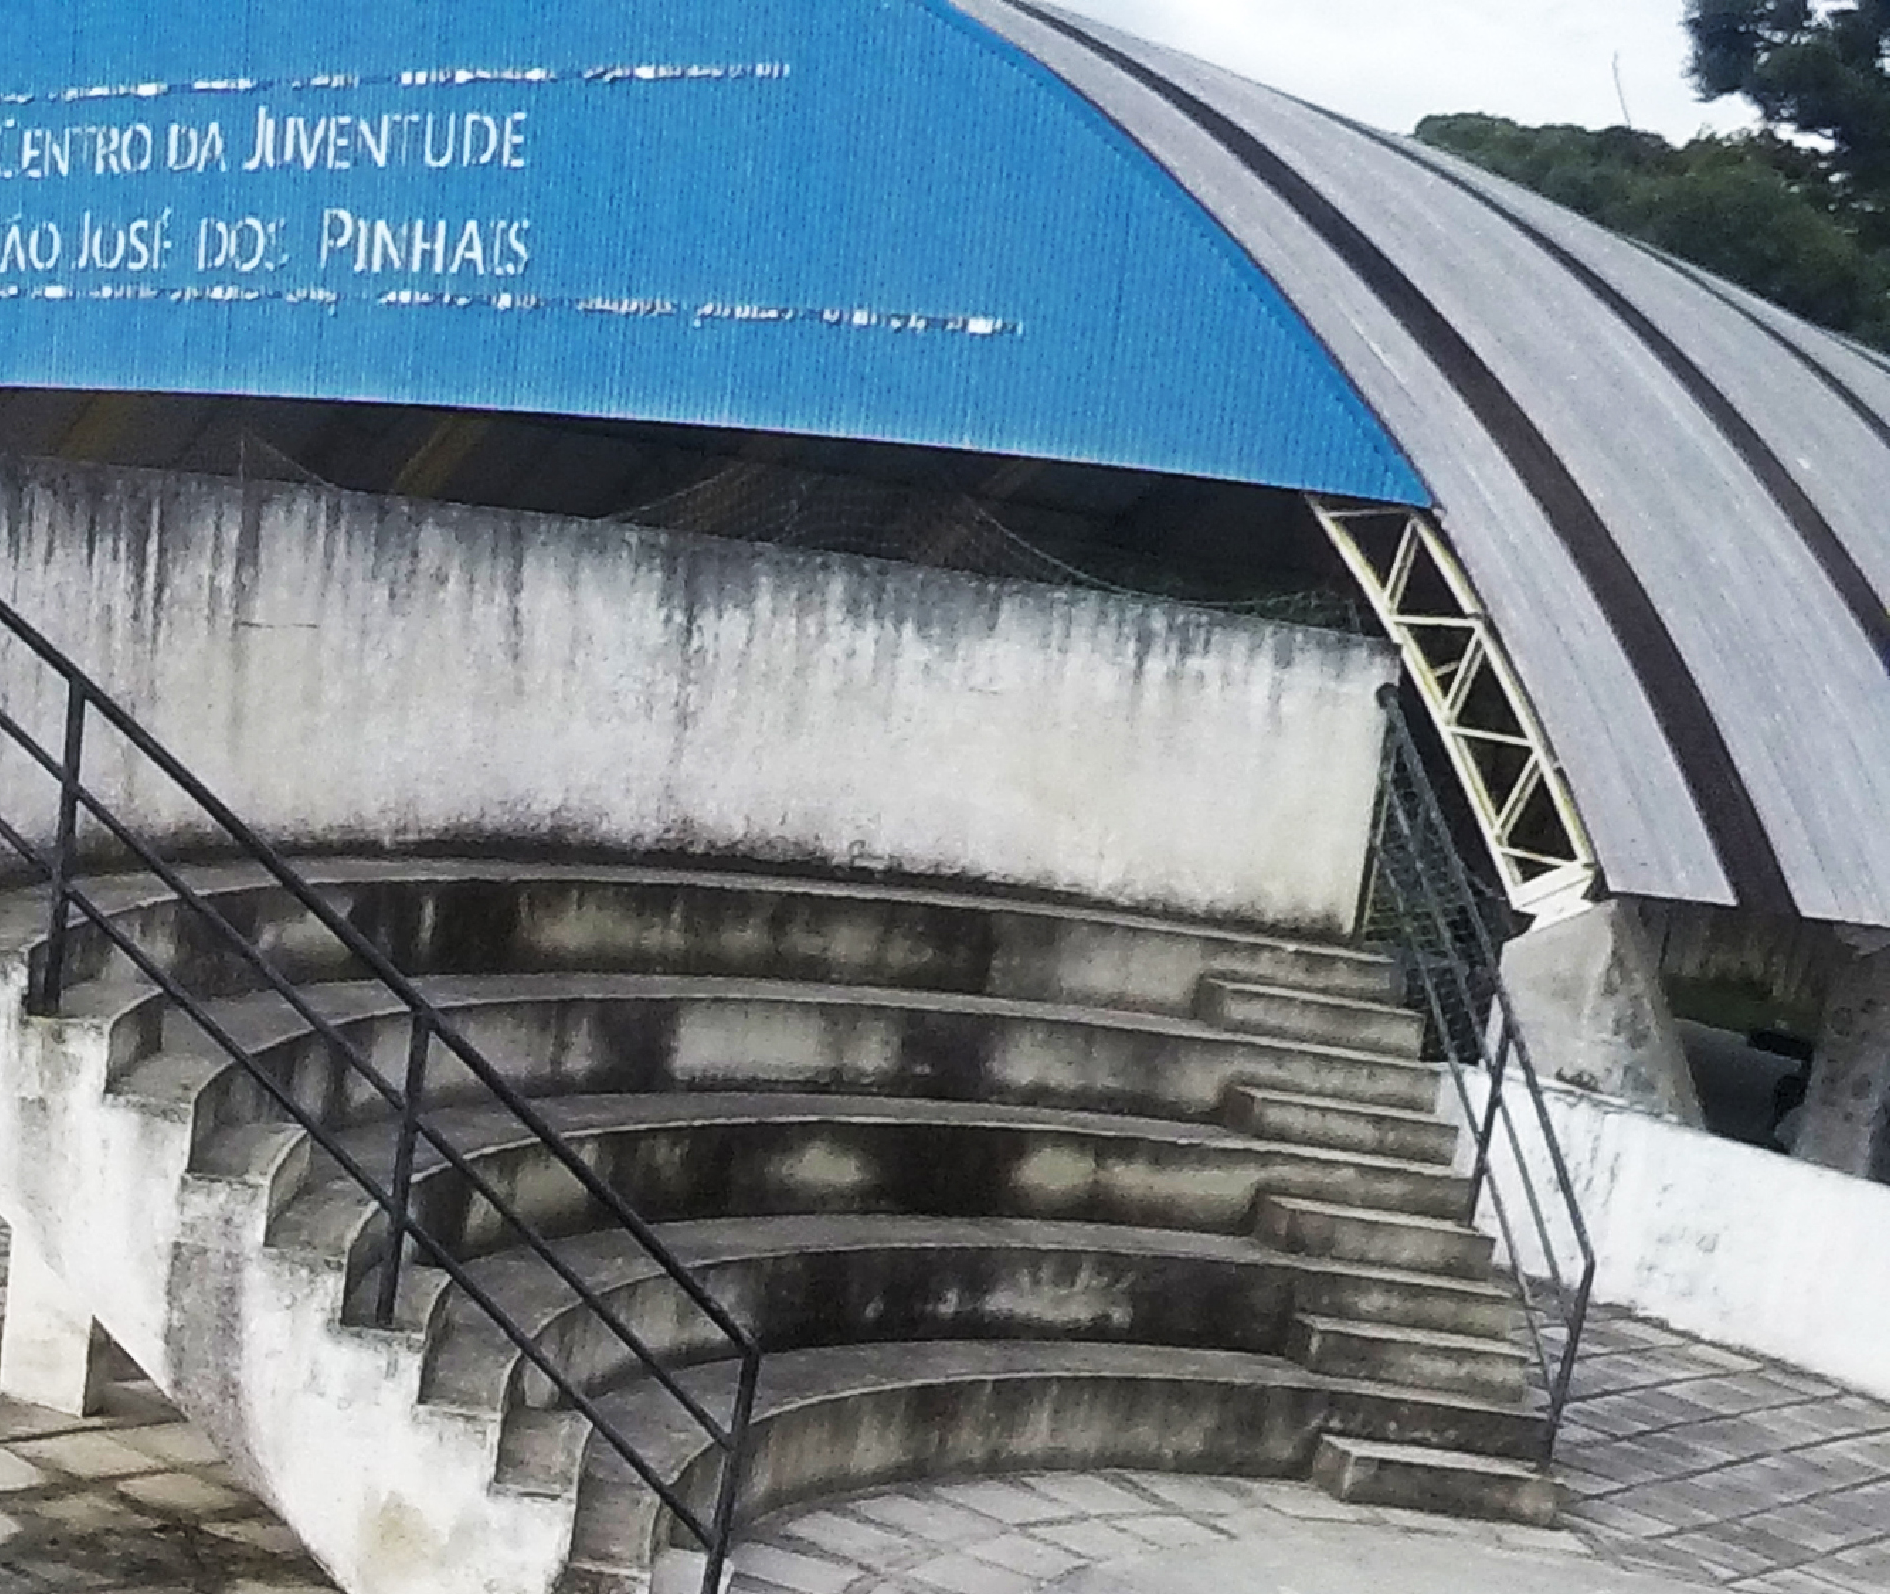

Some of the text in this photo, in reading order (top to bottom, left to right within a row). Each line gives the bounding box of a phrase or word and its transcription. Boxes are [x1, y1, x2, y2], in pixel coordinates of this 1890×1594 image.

[167, 121, 227, 172] DA
[242, 105, 527, 170] JUVENTUDE
[197, 216, 289, 272] DOS
[320, 207, 530, 275] PINHAIS
